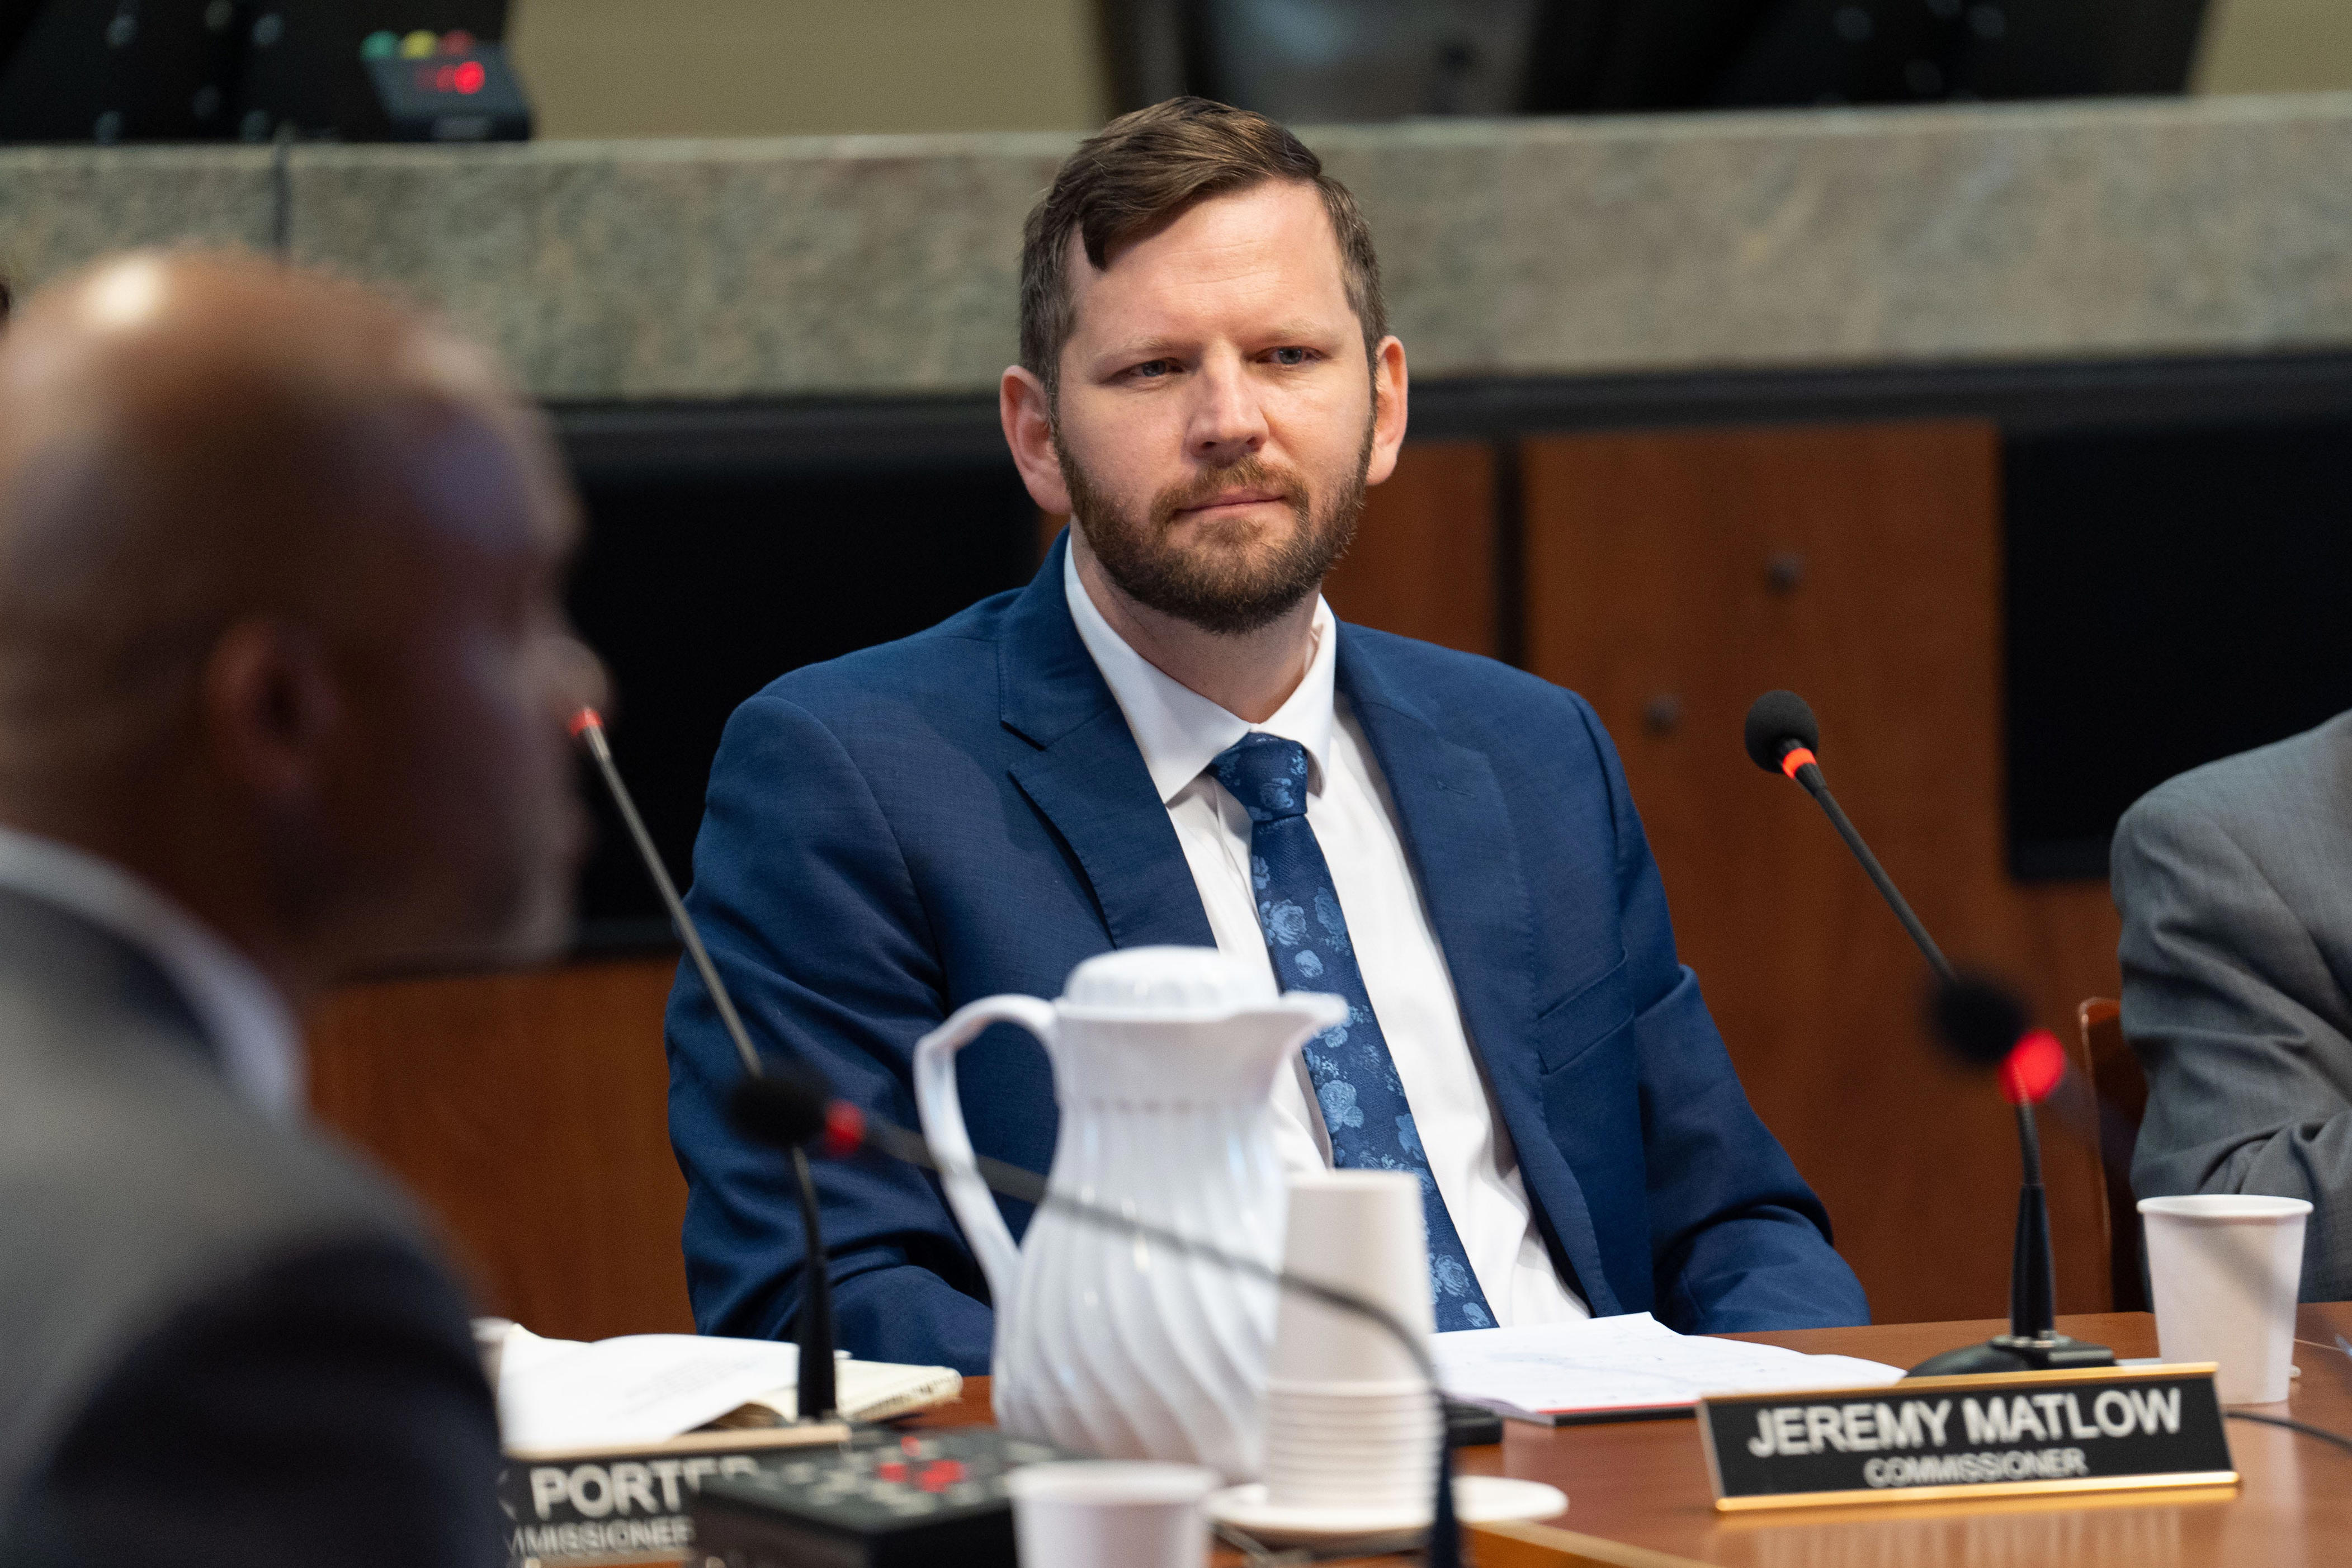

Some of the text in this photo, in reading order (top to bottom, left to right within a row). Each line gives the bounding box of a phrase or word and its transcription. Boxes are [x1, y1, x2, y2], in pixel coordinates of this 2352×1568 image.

[1748, 1387, 2180, 1457] JEREMY MATLOW
[1863, 1447, 2089, 1488] COMMISSIONER
